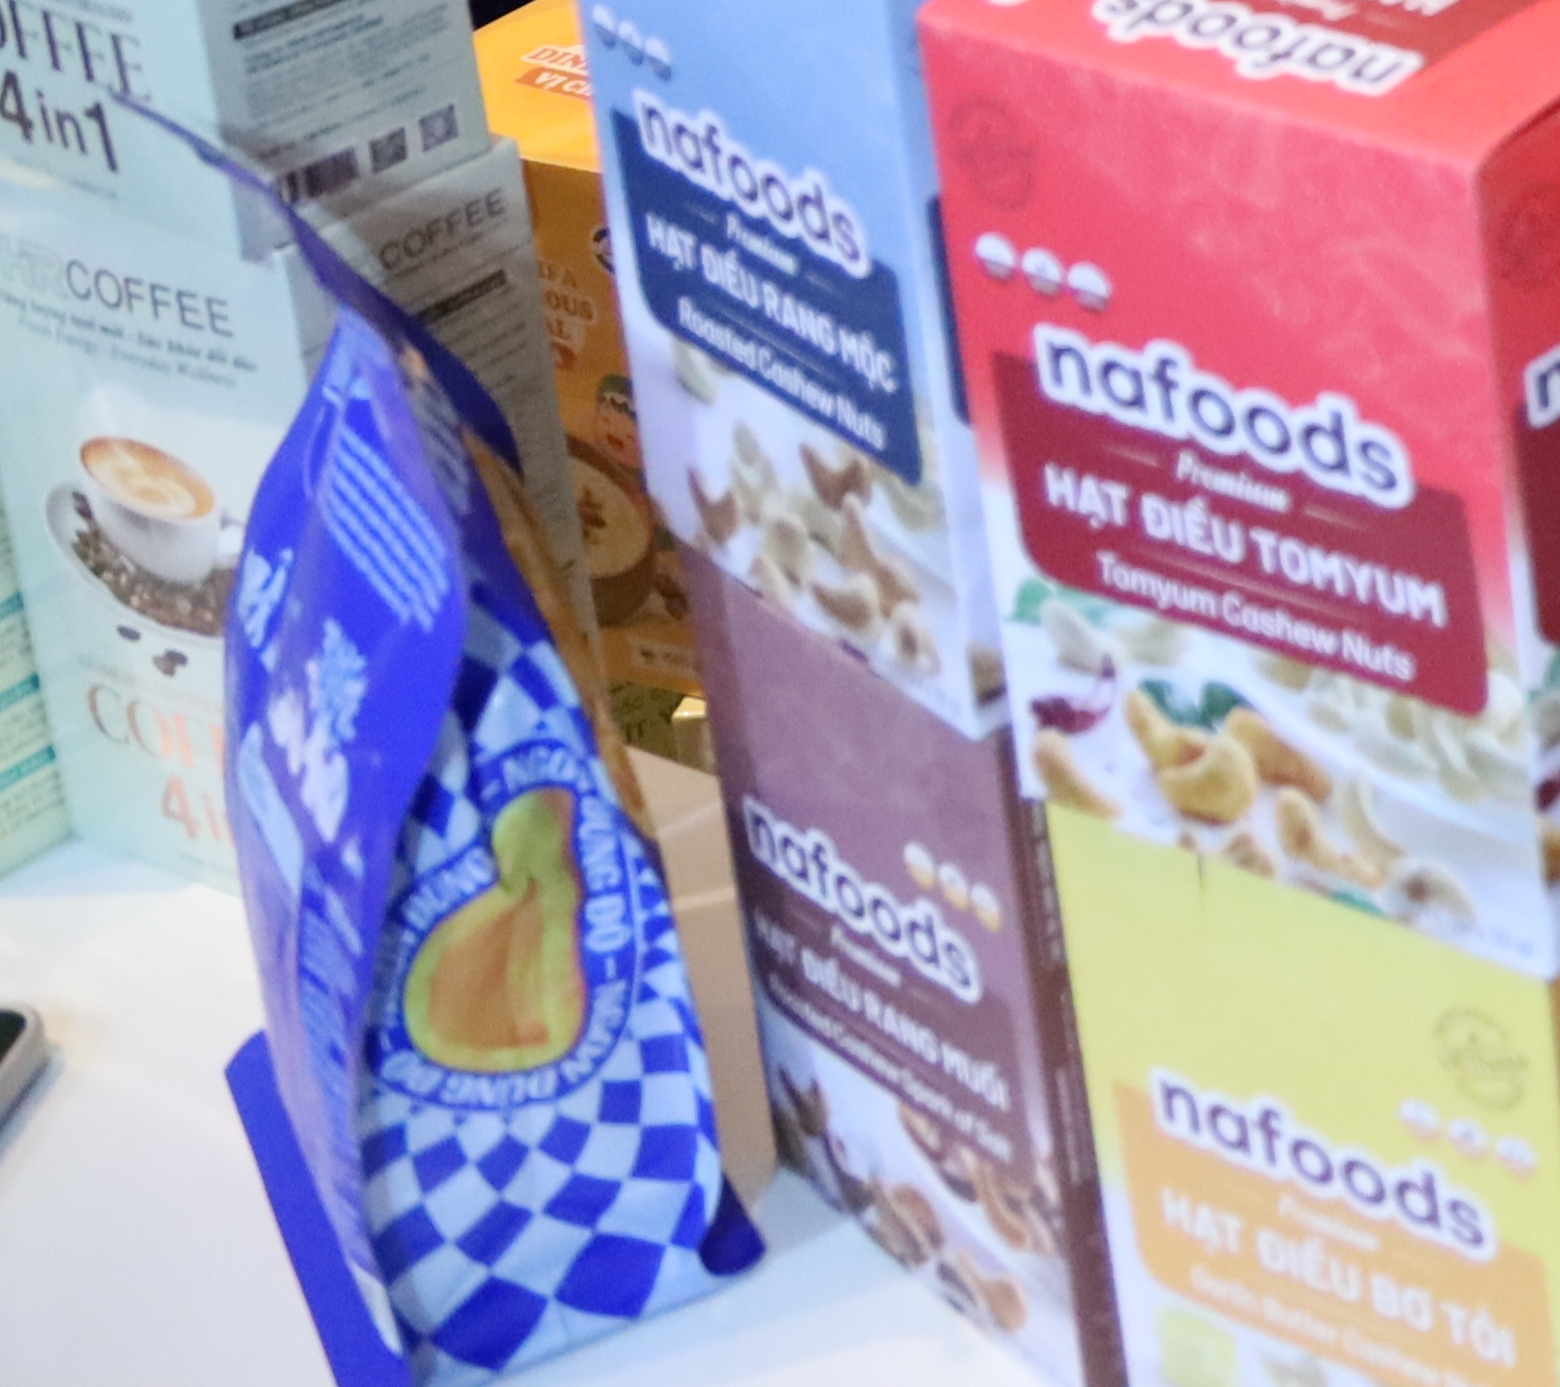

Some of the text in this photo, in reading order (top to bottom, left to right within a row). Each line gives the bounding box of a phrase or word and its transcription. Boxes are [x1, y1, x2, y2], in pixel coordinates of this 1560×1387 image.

[378, 187, 506, 270] COFFEE
[638, 99, 866, 269] nafoods
[66, 258, 235, 339] COFFEE
[646, 212, 697, 271] HẠT
[763, 281, 837, 356] RANG
[1045, 339, 1400, 492] nafoods
[1044, 463, 1448, 629] HẠT ĐIỀU TOMYUM
[1096, 549, 1416, 682] Tomyum Cashew Nuts
[747, 808, 976, 993] nafoods
[1159, 1079, 1486, 1248] nafoods
[1161, 1187, 1241, 1255] HẠT
